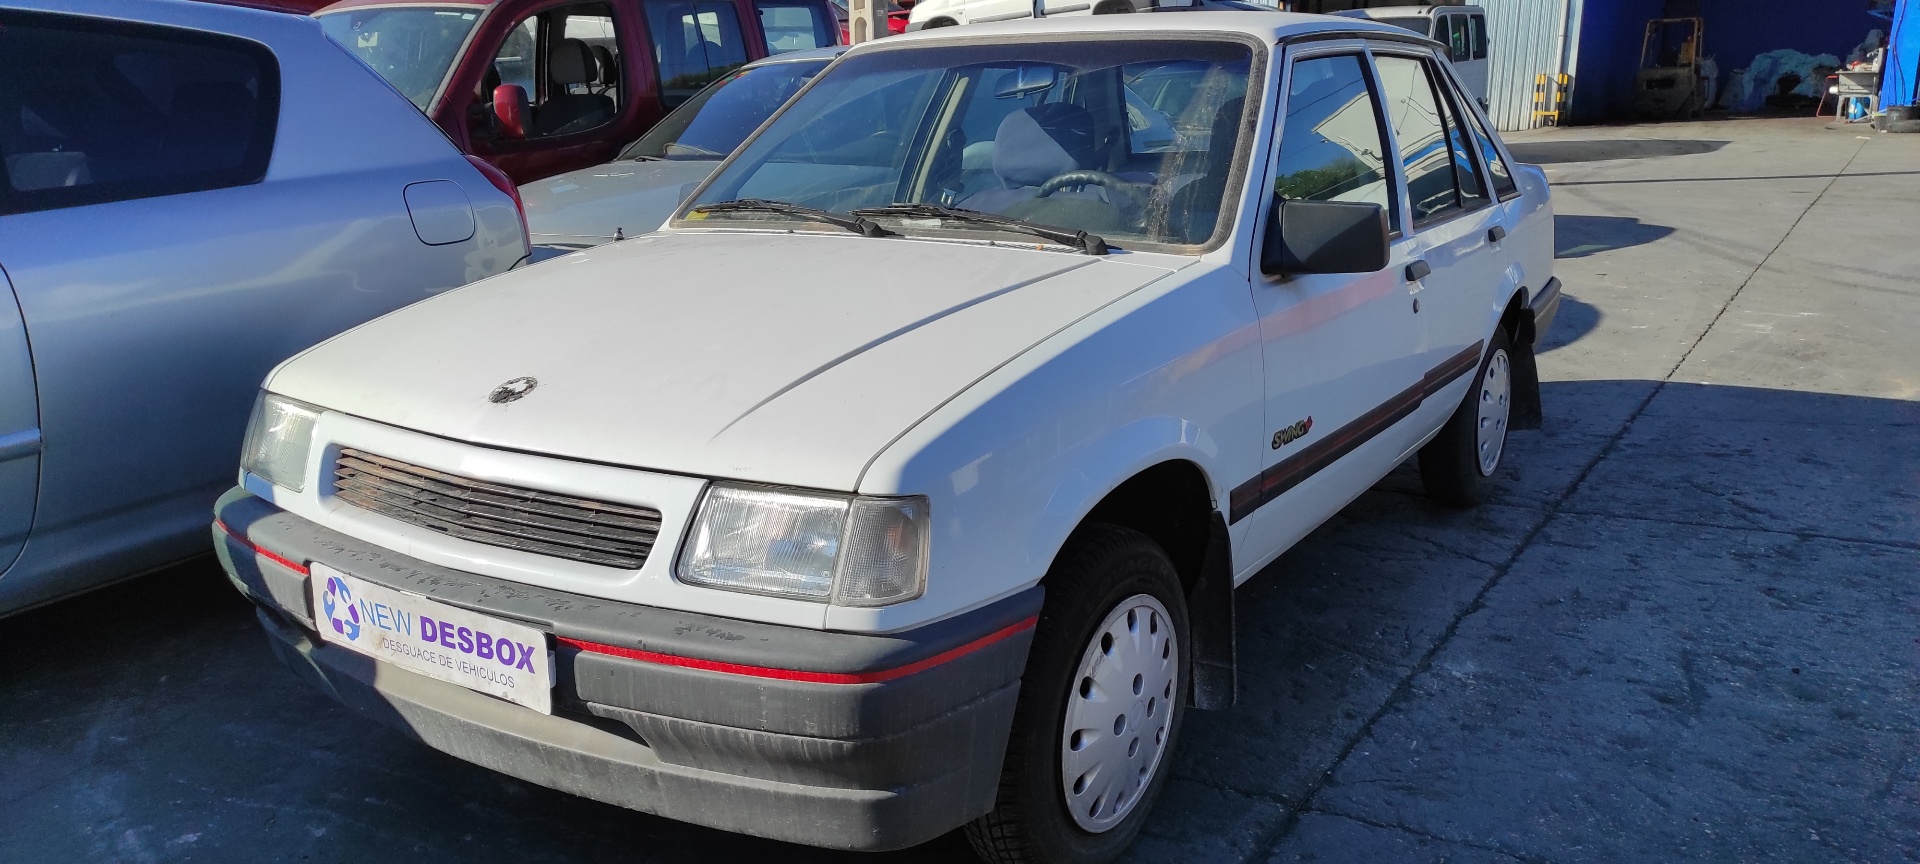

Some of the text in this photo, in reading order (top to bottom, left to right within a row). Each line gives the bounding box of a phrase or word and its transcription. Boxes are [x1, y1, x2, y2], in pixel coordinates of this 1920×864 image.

[1272, 420, 1305, 449] SWING
[359, 598, 536, 674] NEW DESBOX
[382, 637, 515, 688] DESGUACE DE VEHICULOS
